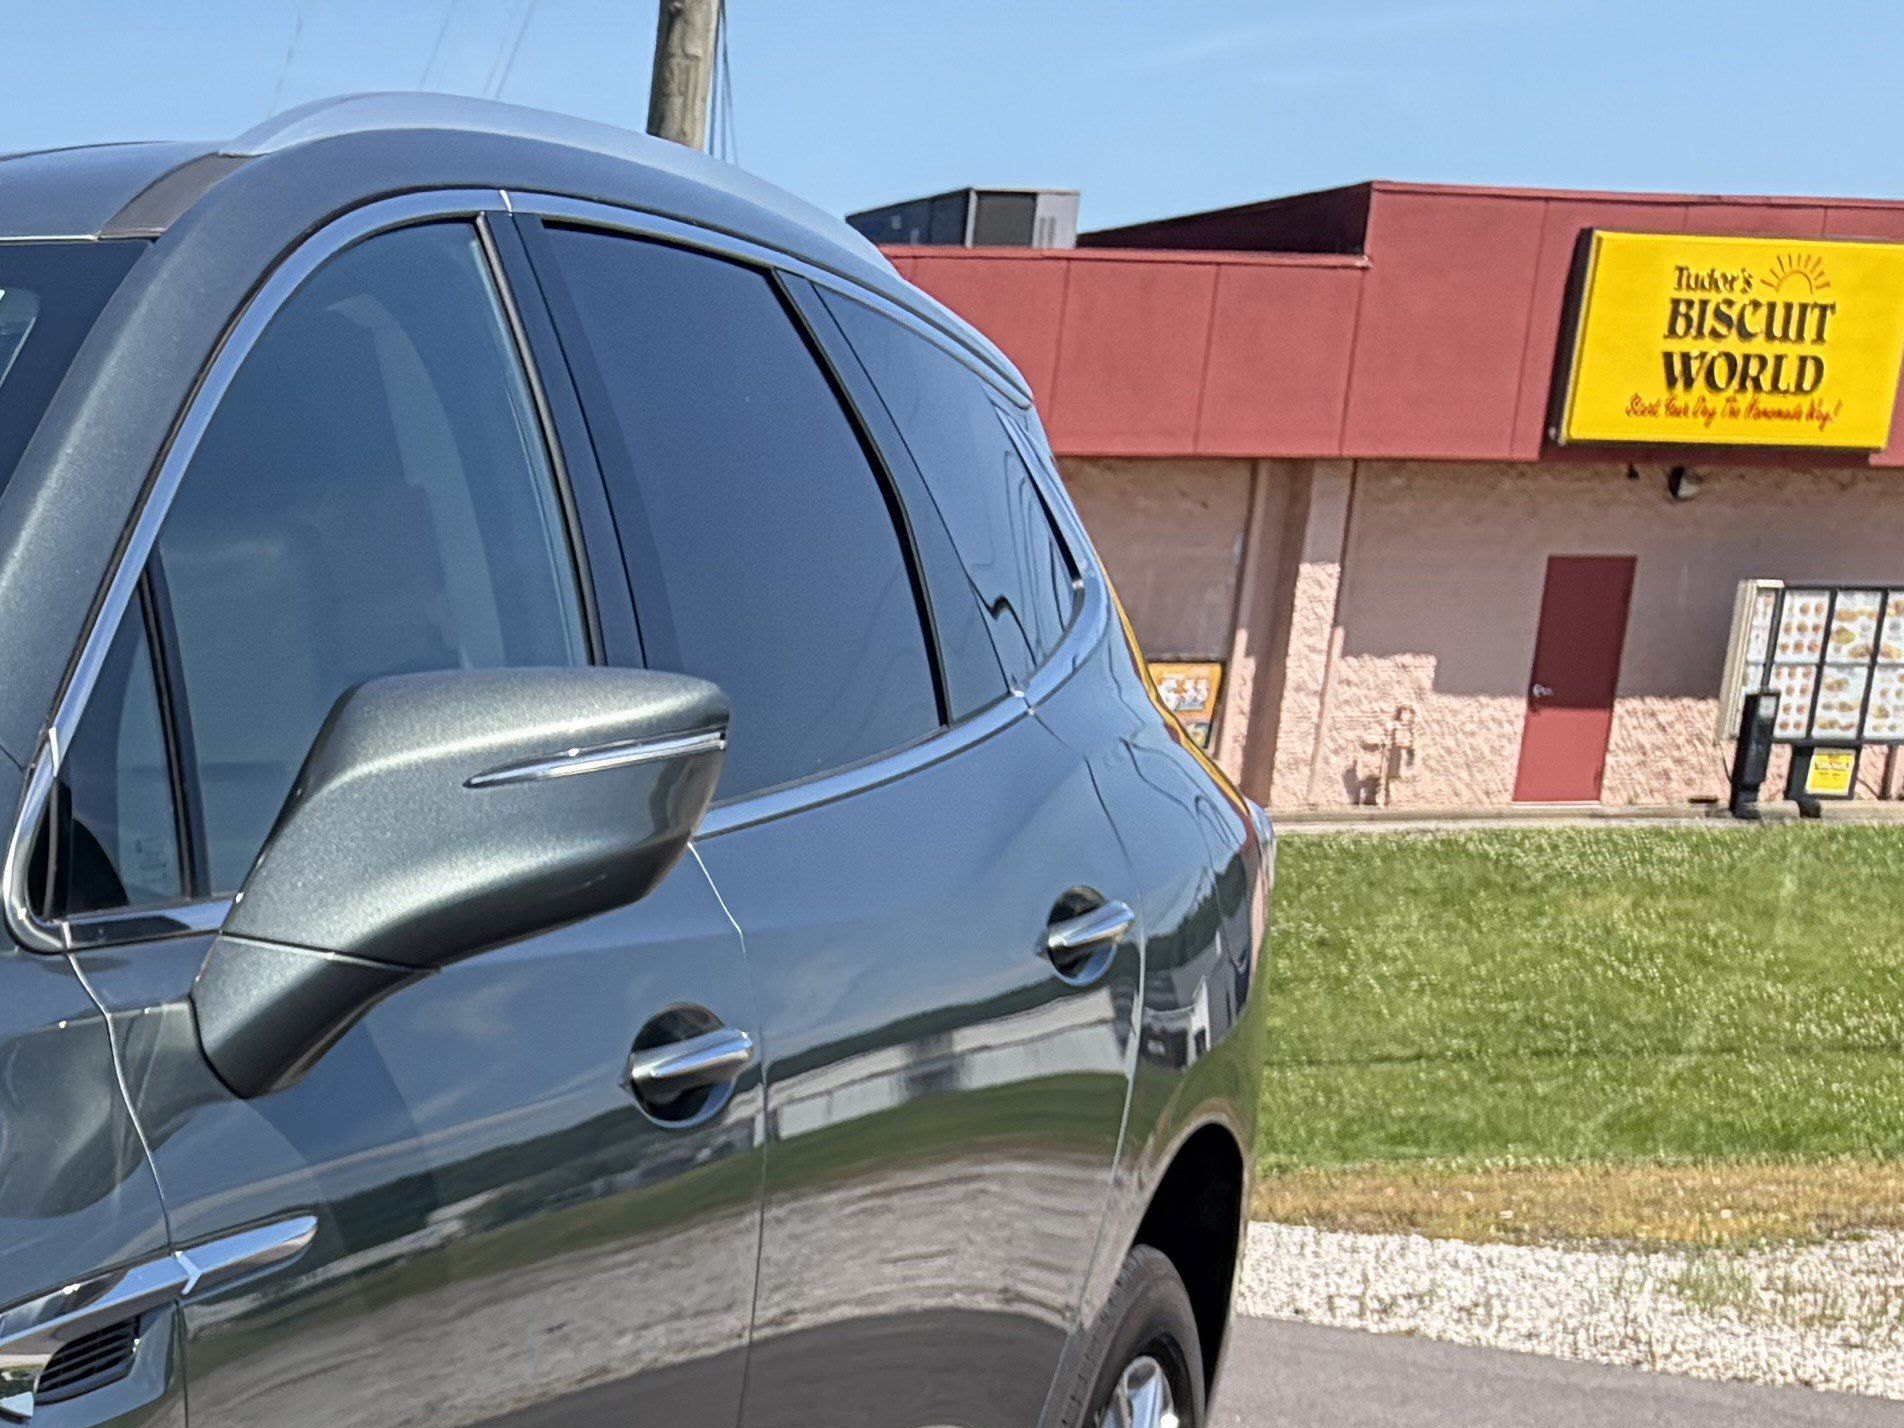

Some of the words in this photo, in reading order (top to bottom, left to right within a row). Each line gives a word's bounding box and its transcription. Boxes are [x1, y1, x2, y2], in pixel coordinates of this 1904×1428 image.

[1673, 264, 1753, 295] Tudor's
[1663, 297, 1837, 345] BISCUIT
[1661, 350, 1825, 397] WORLD
